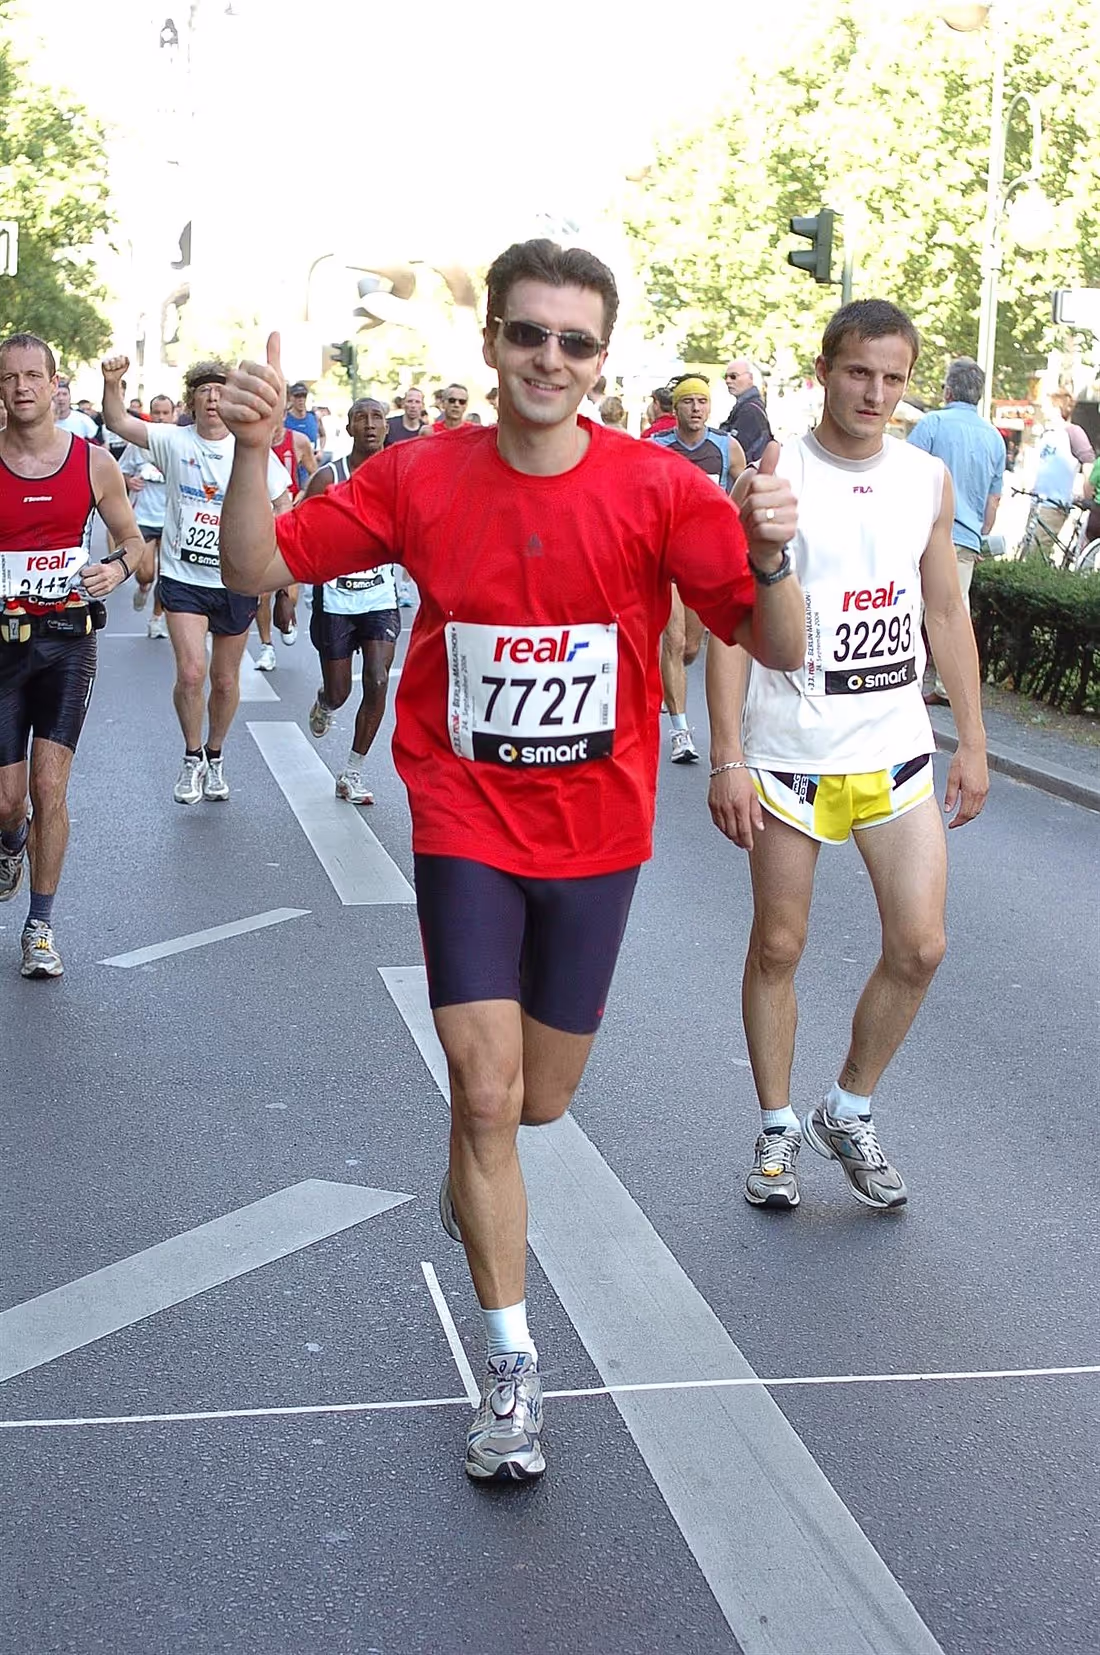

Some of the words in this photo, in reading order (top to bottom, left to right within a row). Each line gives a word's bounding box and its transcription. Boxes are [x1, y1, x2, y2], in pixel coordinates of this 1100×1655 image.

[853, 486, 873, 494] FILA
[194, 511, 220, 526] rea
[833, 613, 912, 663] 32293
[865, 664, 908, 688] smart
[461, 674, 470, 717] September
[481, 675, 597, 726] 7727
[521, 739, 588, 763] smart
